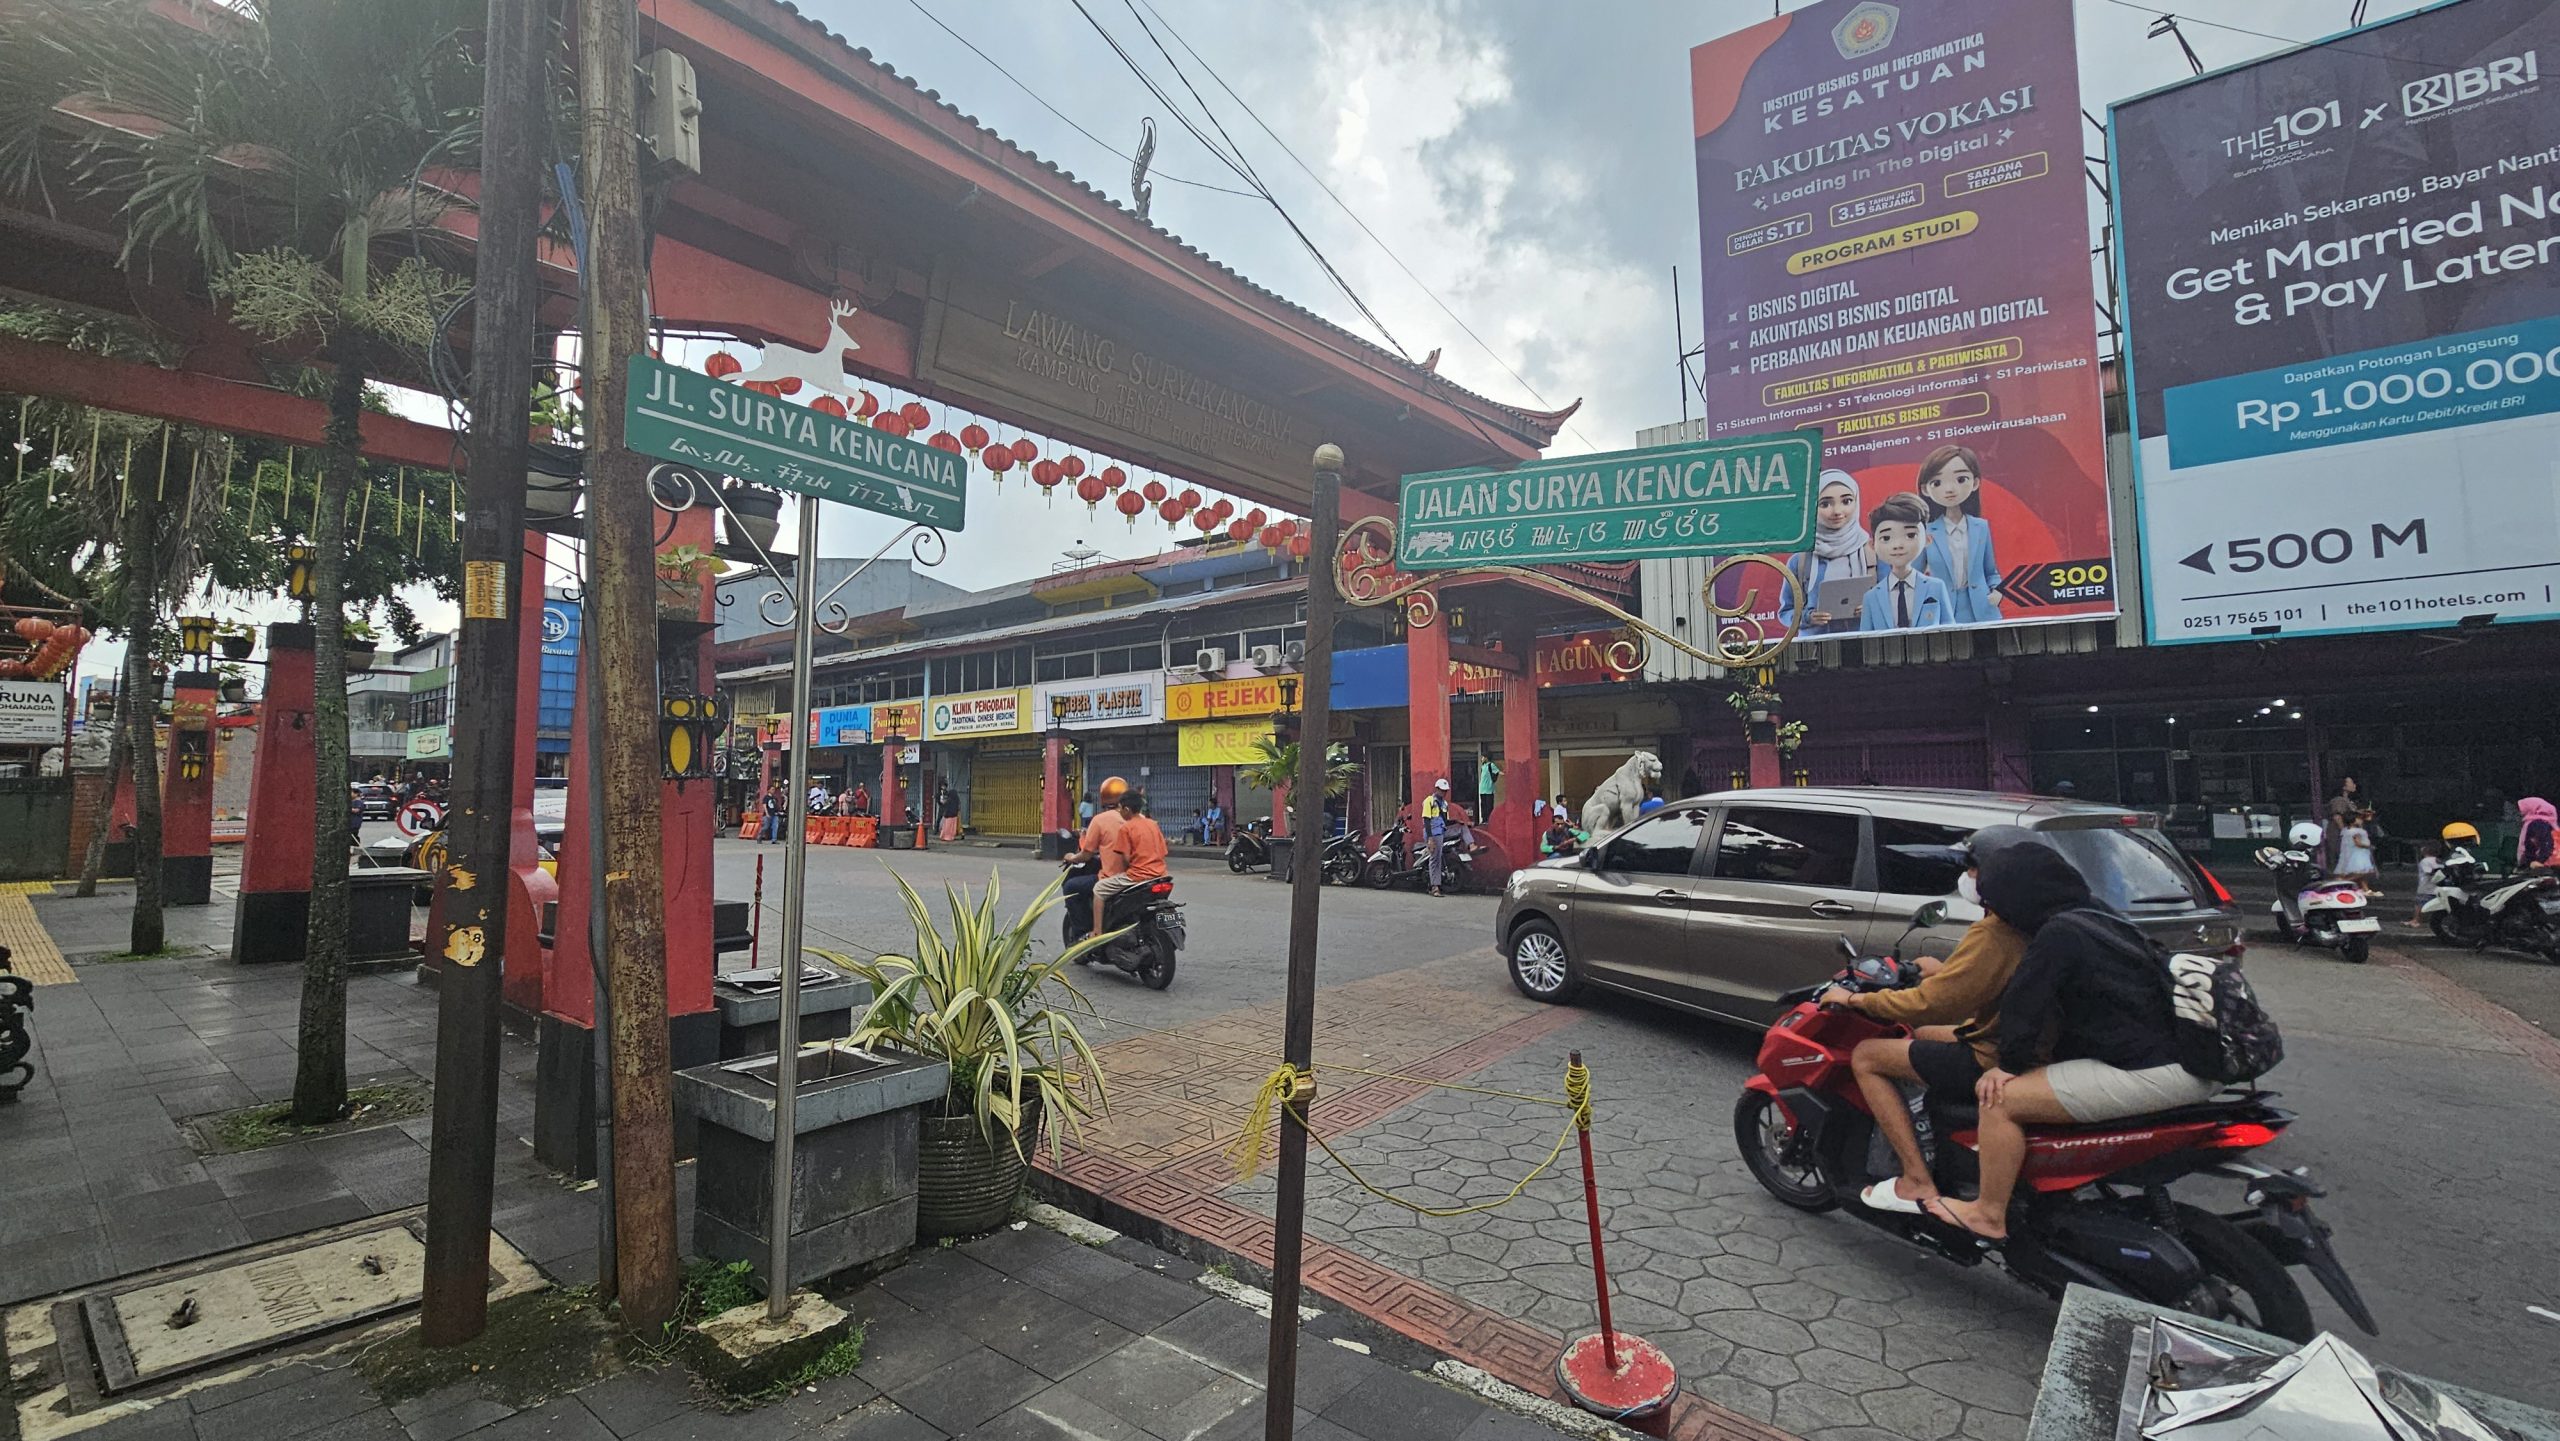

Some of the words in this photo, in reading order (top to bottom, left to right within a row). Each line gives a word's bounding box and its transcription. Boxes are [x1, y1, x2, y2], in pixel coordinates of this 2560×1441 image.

[1763, 86, 1814, 114] INSTITUT
[1818, 72, 1859, 96] BISNIS
[1862, 61, 1889, 85] DAN
[1893, 32, 1984, 76] INFORMATIKA
[2453, 50, 2539, 103] BRI
[1765, 49, 1985, 135] KESATUAN
[1734, 127, 1892, 192] FAKULTAS
[1897, 85, 2034, 141] VOKASI
[2251, 139, 2313, 160] HOTEL
[1773, 174, 1846, 206] Leading
[1852, 166, 1871, 186] In
[1875, 153, 1913, 180] The
[1920, 133, 1989, 164] Digital
[1967, 159, 2023, 182] SARJANA
[2263, 150, 2302, 164] BOGOR
[1967, 169, 2022, 190] TERAPAN
[1838, 202, 1866, 222] 3.5
[1868, 195, 1916, 214] SARJANA
[1869, 194, 1895, 206] TAHUN
[1897, 189, 1914, 200] JADI
[2211, 210, 2298, 246] Menikah
[2303, 183, 2417, 223] Sekarang,
[2421, 164, 2492, 194] Bayar
[1734, 230, 1763, 242] DENGAN
[1734, 236, 1763, 251] GELAR
[1766, 219, 1805, 242] S.Tr
[1801, 233, 1895, 268] PROGRAM
[1902, 218, 1960, 244] STUDI
[2166, 254, 2254, 299] Get
[2266, 201, 2483, 279] Married
[1748, 293, 1796, 322] BISNIS
[1800, 280, 1859, 310] DIGITAL
[2234, 292, 2272, 326] &
[2284, 271, 2389, 317] Pay
[1749, 317, 1834, 349] AKUNTANSI
[1838, 303, 1890, 330] BISNIS
[1894, 285, 1959, 316] DIGITAL
[1750, 337, 1842, 374] PERBANKAN
[1846, 325, 1880, 352] DAN
[1883, 310, 1975, 346] KEUANGAN
[1980, 296, 2048, 328] DIGITAL
[1003, 299, 1115, 373] LAWANG
[1129, 352, 1293, 443] SURYAKANCANA
[1016, 347, 1100, 394] KAMPUNG
[1774, 376, 1829, 401] FAKULTAS
[1832, 361, 1913, 390] INFORMATIKA
[1917, 359, 1926, 373] &
[1929, 344, 2008, 370] PARIWISATA
[1996, 368, 2011, 379] S1
[2015, 356, 2087, 377] Pariwisata
[2284, 361, 2355, 385] Dapatkan
[2358, 347, 2432, 371] Potongan
[2436, 333, 2519, 358] Langsung
[1838, 397, 1852, 408] S1
[1854, 384, 1915, 406] Teknologi
[1918, 373, 1978, 393] Informasi
[1716, 421, 1728, 432] S1
[1730, 412, 1767, 429] Sistem
[1769, 401, 1823, 422] Informasi
[1837, 411, 1896, 434] FAKULTAS
[1900, 405, 1940, 424] BISNIS
[1927, 429, 1942, 440] S1
[1944, 411, 2067, 438] Biokewirausahaan
[2236, 396, 2300, 431] Rp
[2289, 418, 2376, 442] Menggunakan
[2379, 410, 2415, 427] Kartu
[2416, 398, 2498, 423] Debit/Kredit
[2501, 395, 2526, 409] BRI
[646, 369, 694, 412] JL.
[708, 387, 818, 448] SURYA
[829, 426, 957, 488] KENCANA
[1825, 447, 1838, 457] S1
[1841, 436, 1910, 456] Manajemen
[1415, 481, 1500, 521] JALAN
[1506, 471, 1602, 513] SURYA
[1615, 452, 1791, 503] KENCANA
[2227, 527, 2354, 574] 500
[2371, 517, 2429, 559] M
[2049, 565, 2108, 588] 300
[2053, 584, 2105, 599] METER
[2347, 588, 2526, 616] the101hotels.com
[2183, 613, 2222, 629] 0251
[2227, 610, 2268, 625] 7565
[2274, 607, 2303, 622] 101
[952, 701, 972, 715] KLINIK
[975, 696, 1016, 714] PENGOBATAN
[1096, 689, 1142, 710] PLASTIK
[1204, 686, 1275, 708] REJEKI
[829, 711, 859, 723] DUNIA
[952, 716, 976, 725] TRADITIONAL
[977, 713, 994, 722] CHINESE
[996, 711, 1015, 720] MEDICINE
[2053, 1136, 2124, 1149] VARIO
